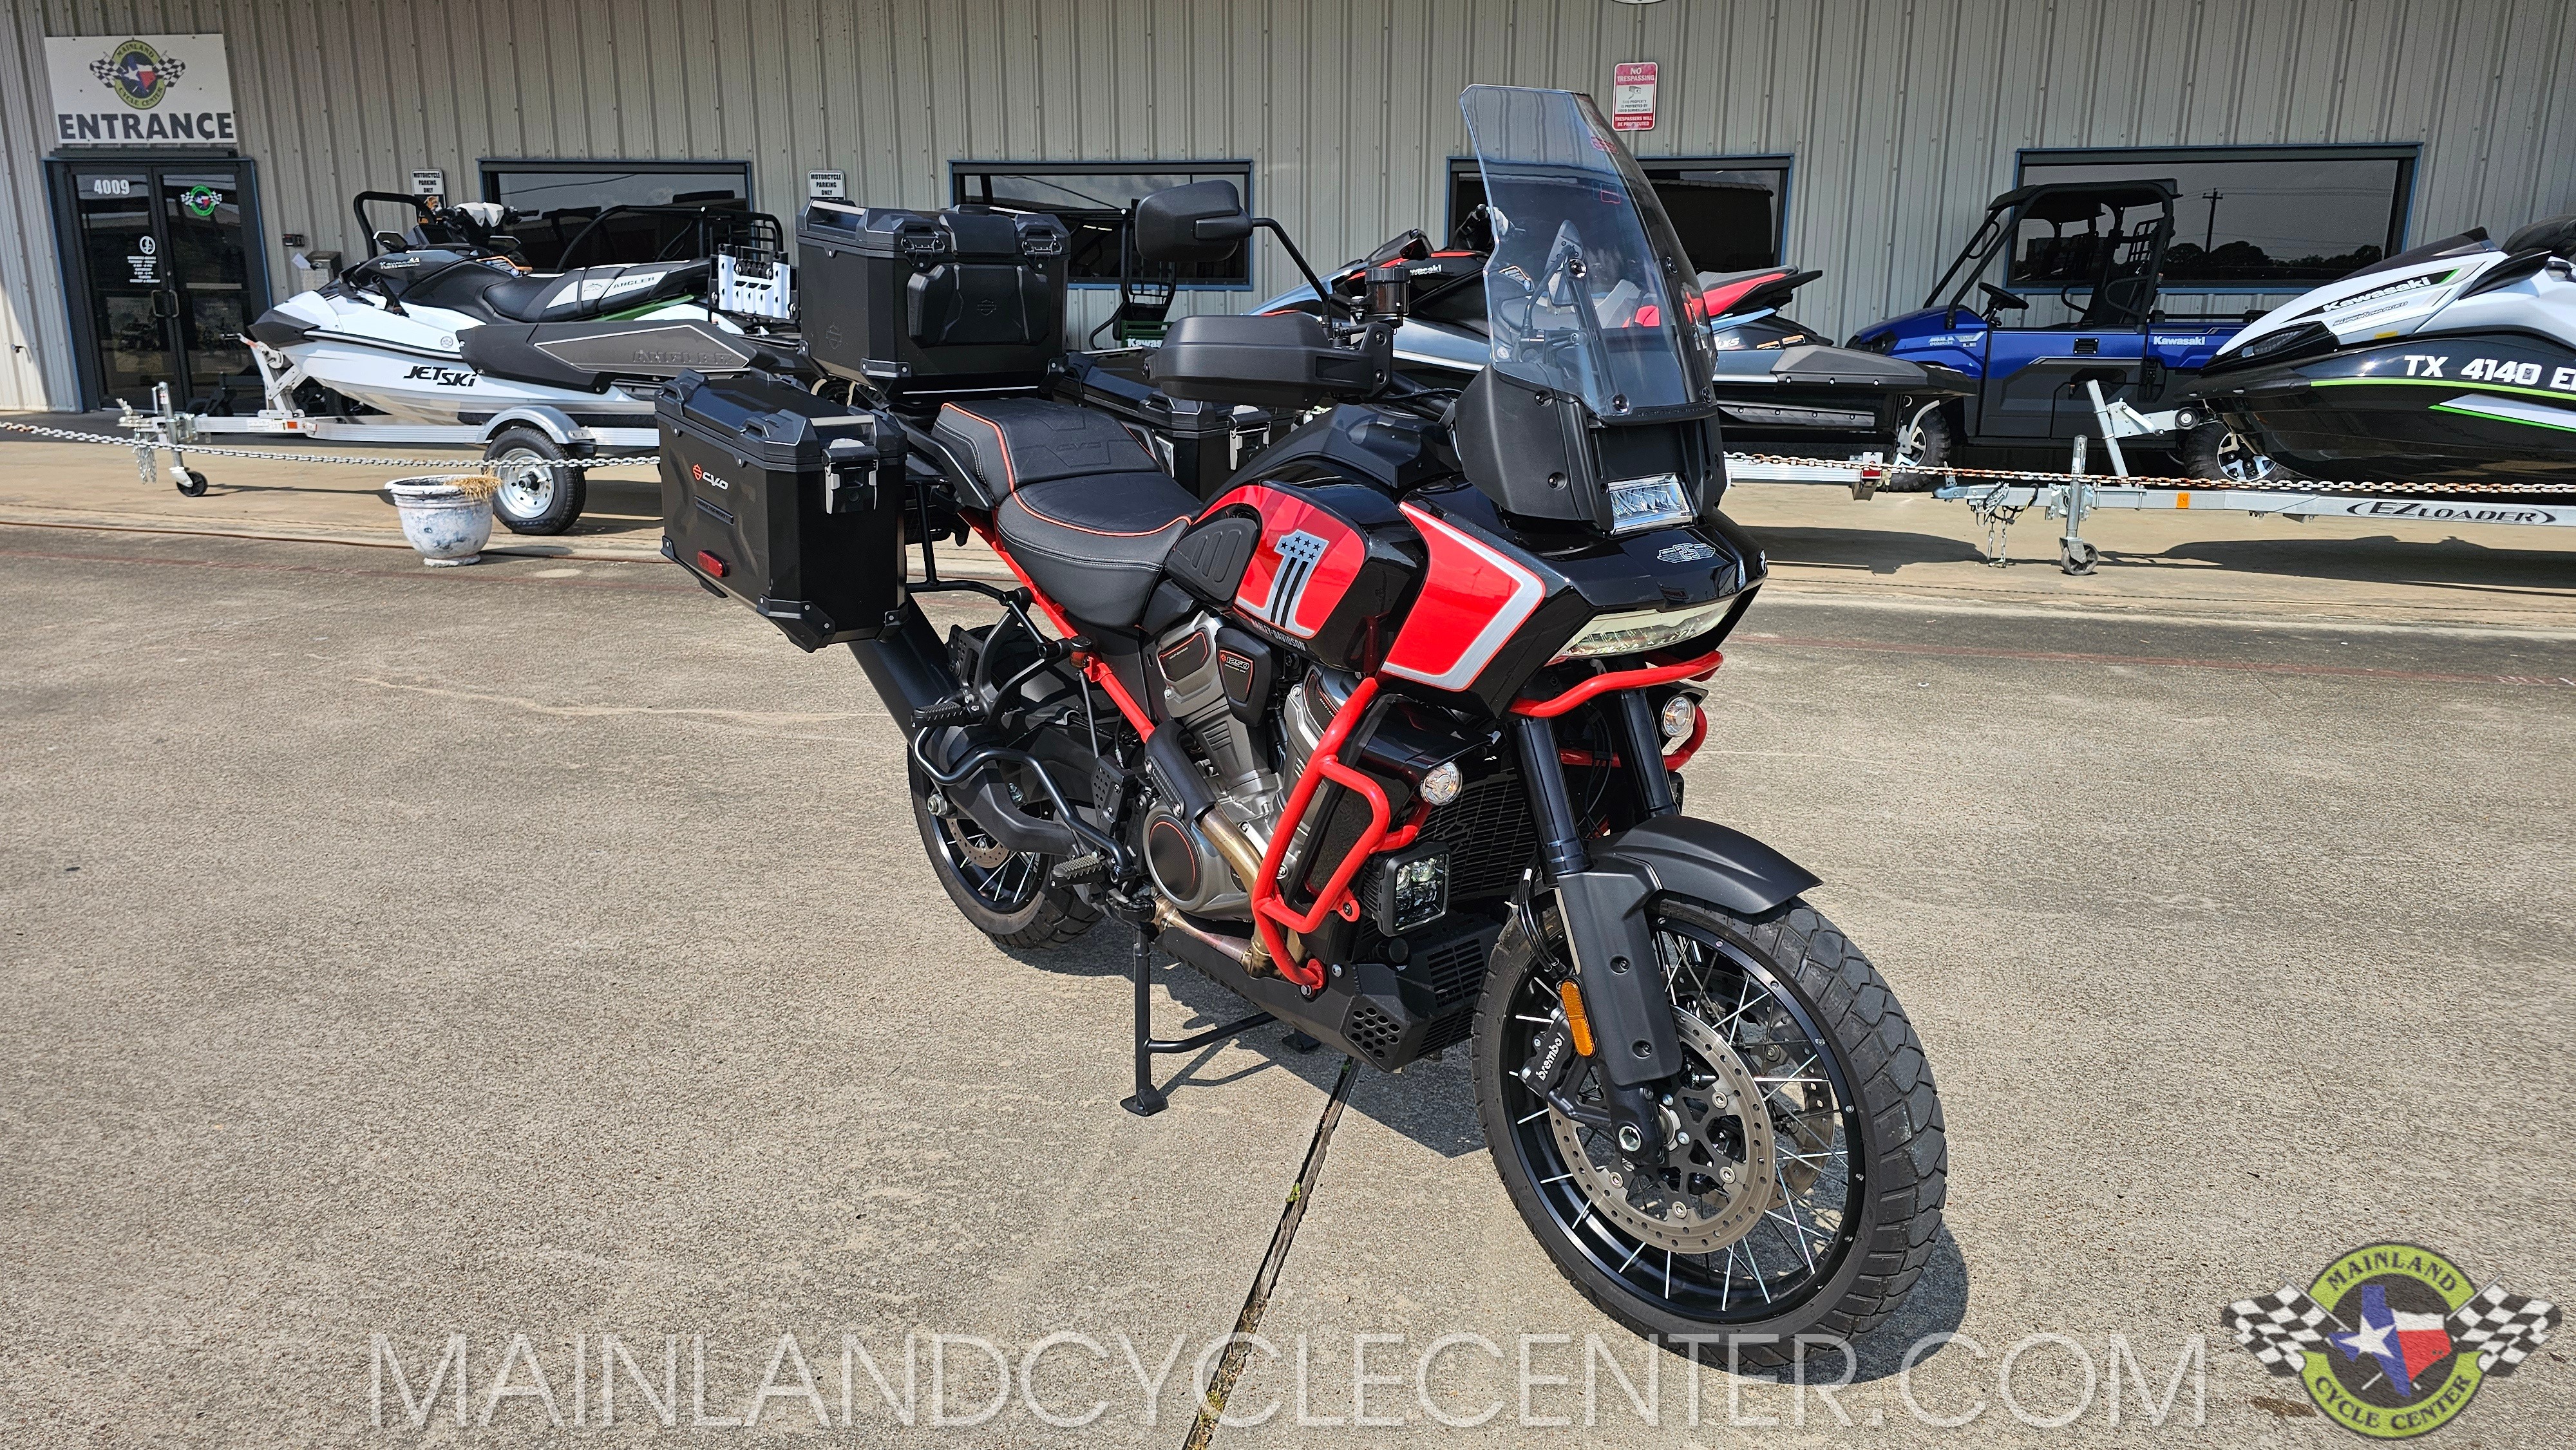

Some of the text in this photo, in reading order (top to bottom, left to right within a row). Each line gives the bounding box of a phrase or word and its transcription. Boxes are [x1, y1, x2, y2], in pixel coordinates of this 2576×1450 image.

[116, 42, 155, 59] MAINLAND
[118, 86, 164, 107] CYCLE CENTER
[58, 112, 234, 140] ENTRANCE
[94, 179, 130, 194] 4009
[1409, 263, 1442, 276] wasaki
[2322, 276, 2431, 312] Kawasaki
[1126, 338, 1163, 348] Kawas
[2153, 335, 2206, 345] Kawasaki
[2404, 355, 2576, 391] TX 4140 E
[702, 471, 729, 490] CVO
[1250, 617, 1307, 652] HARLEY-DAVIDSON
[1226, 656, 1250, 670] 1250
[1535, 1037, 1562, 1081] brembo
